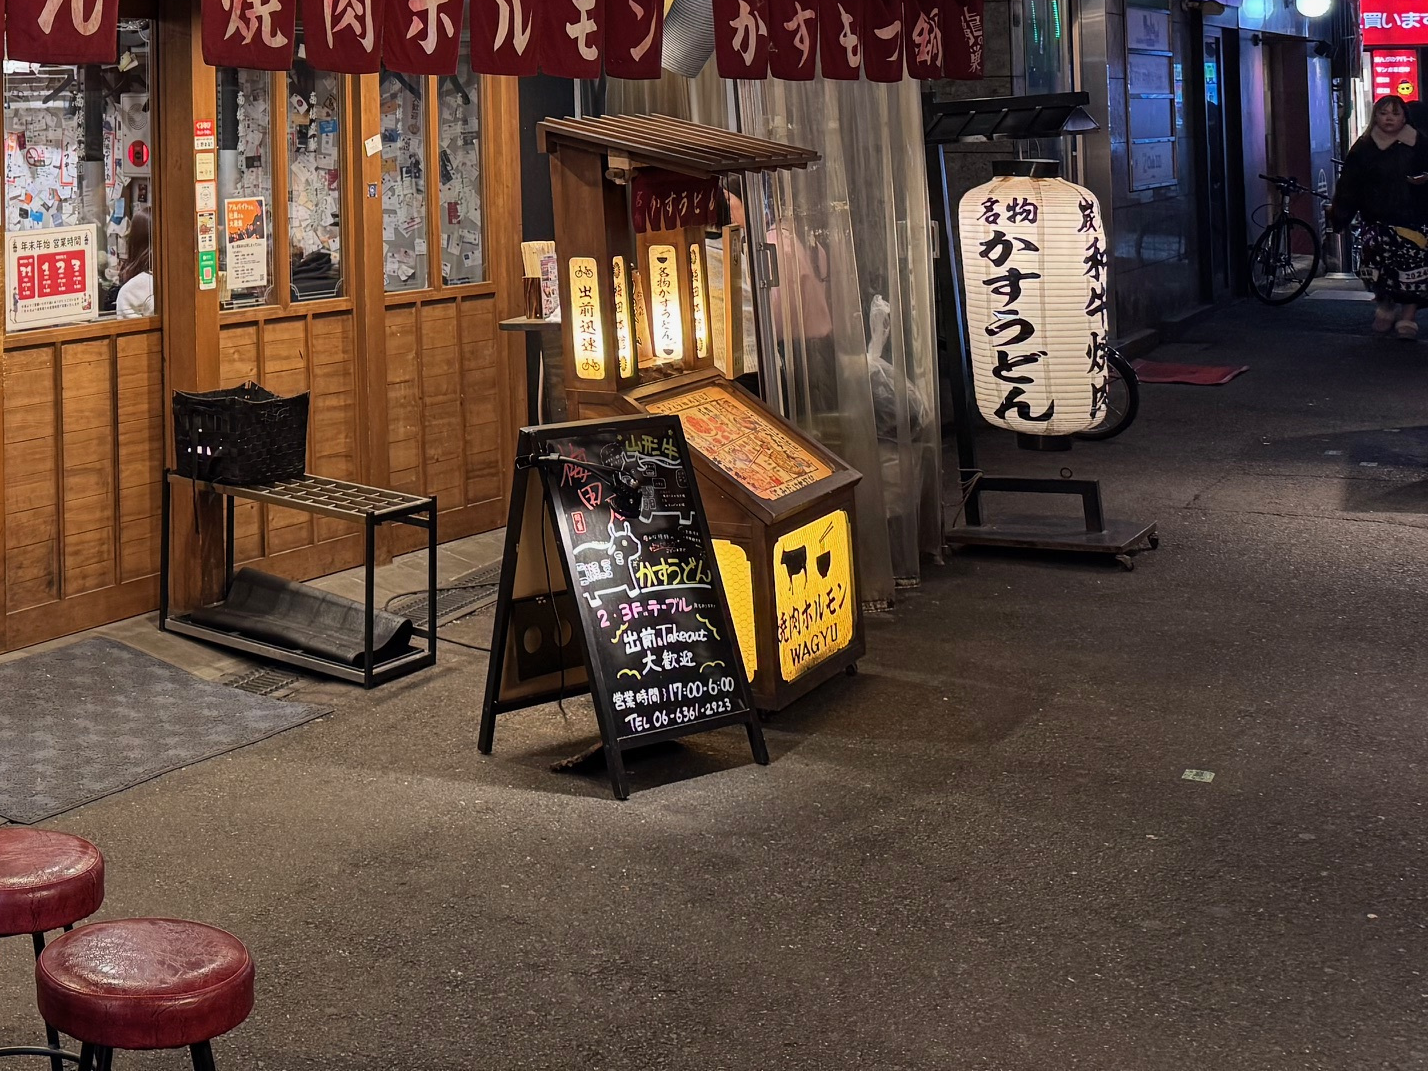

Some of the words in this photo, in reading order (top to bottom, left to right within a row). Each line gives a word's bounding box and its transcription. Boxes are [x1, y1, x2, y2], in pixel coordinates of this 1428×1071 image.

[1360, 12, 1428, 30] 買いま
[977, 197, 1039, 225] 名物
[21, 239, 51, 252] 年末年始
[578, 286, 597, 352] 出前迅速
[979, 230, 1054, 421] かすうどん
[636, 558, 711, 587] かすうどん
[790, 623, 838, 667] WAGYU
[642, 649, 696, 676] 大歓迎
[613, 688, 661, 710] 営業時間
[625, 713, 651, 732] TEL
